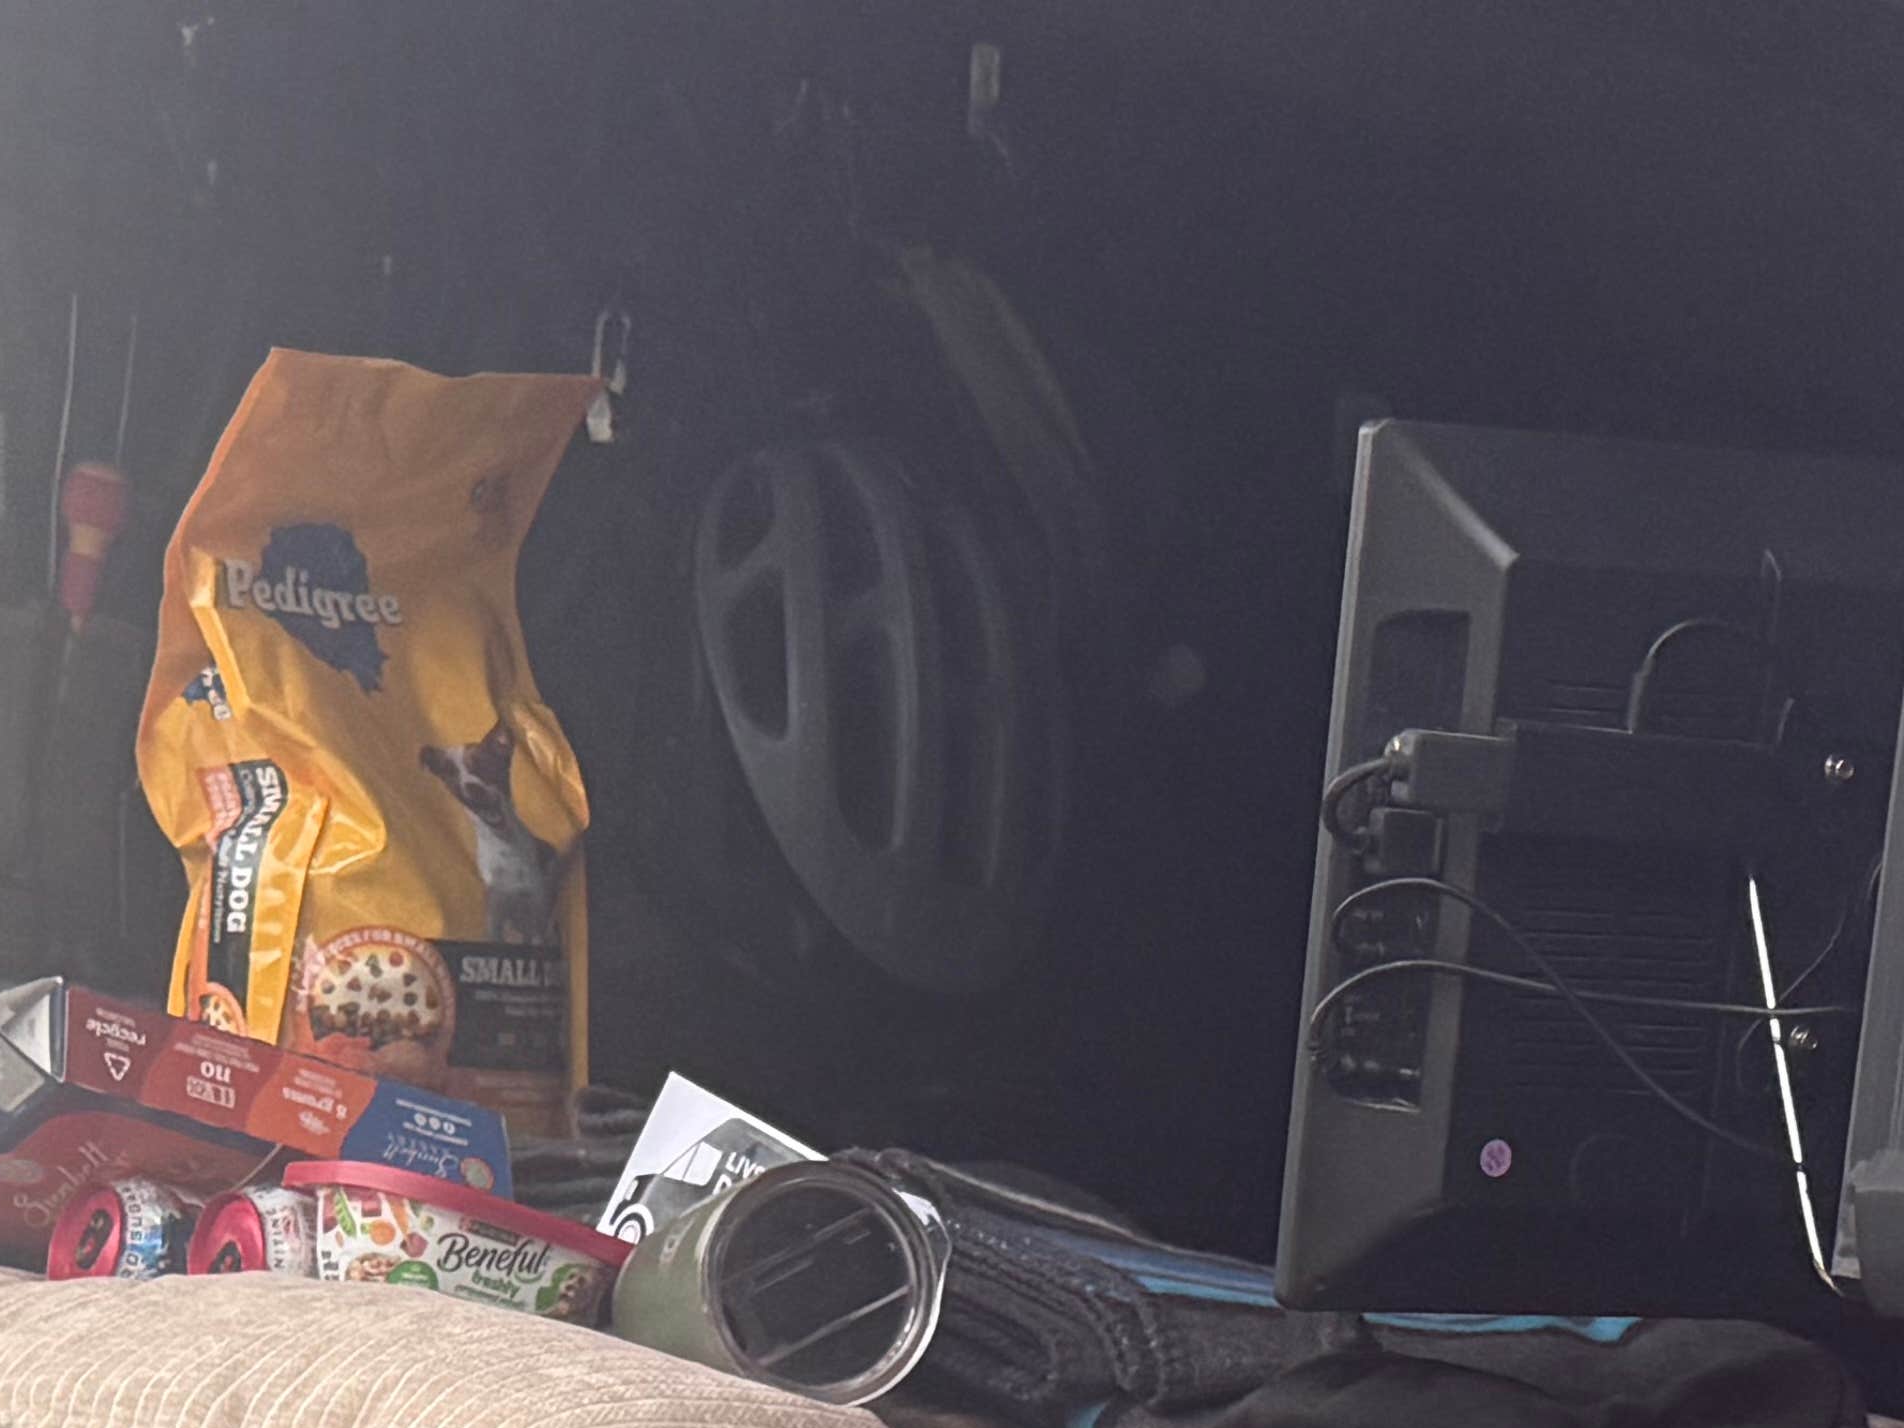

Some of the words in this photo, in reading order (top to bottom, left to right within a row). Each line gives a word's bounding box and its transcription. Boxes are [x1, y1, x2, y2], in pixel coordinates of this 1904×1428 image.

[223, 558, 403, 630] Pedigree
[233, 765, 287, 862] SMALL
[226, 865, 252, 934] DOG
[459, 954, 540, 986] SMALL
[85, 1014, 148, 1048] recycle
[201, 1061, 234, 1085] no
[437, 1232, 549, 1276] Beneful
